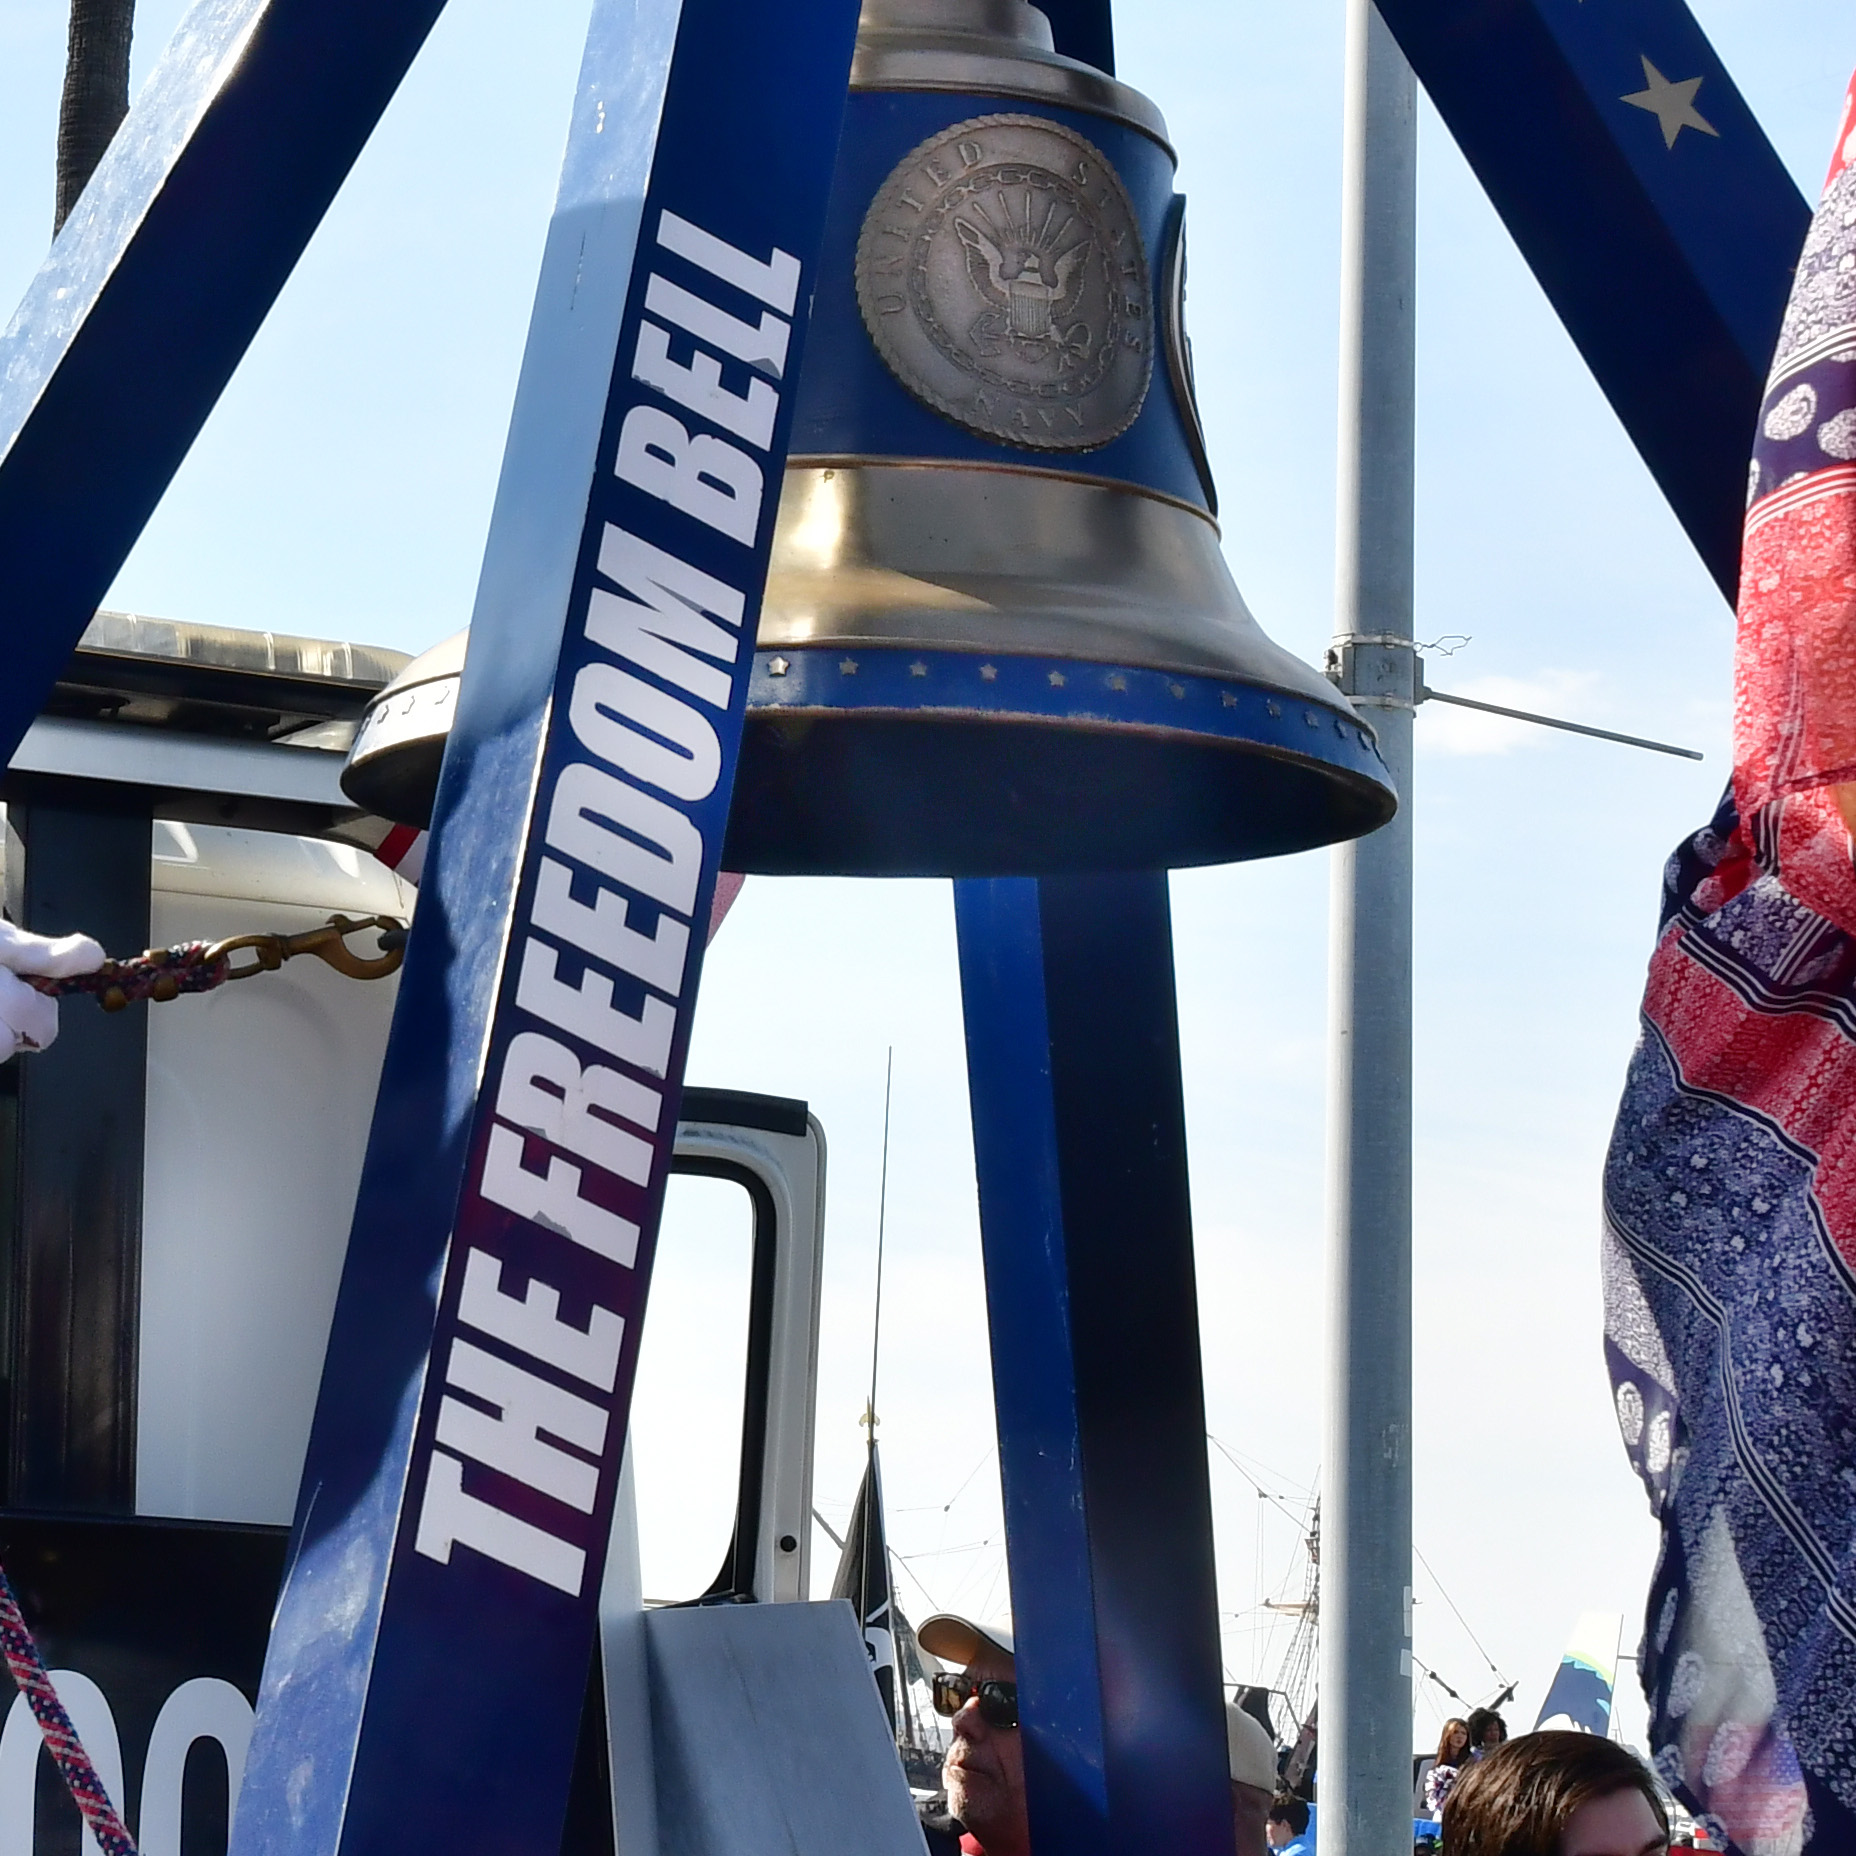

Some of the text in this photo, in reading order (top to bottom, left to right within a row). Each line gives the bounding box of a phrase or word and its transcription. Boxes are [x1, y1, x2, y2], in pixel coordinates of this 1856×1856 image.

[876, 141, 982, 316] UNITED
[972, 388, 1085, 429] NAVY
[414, 209, 801, 1597] THE FREEDOM BELL
